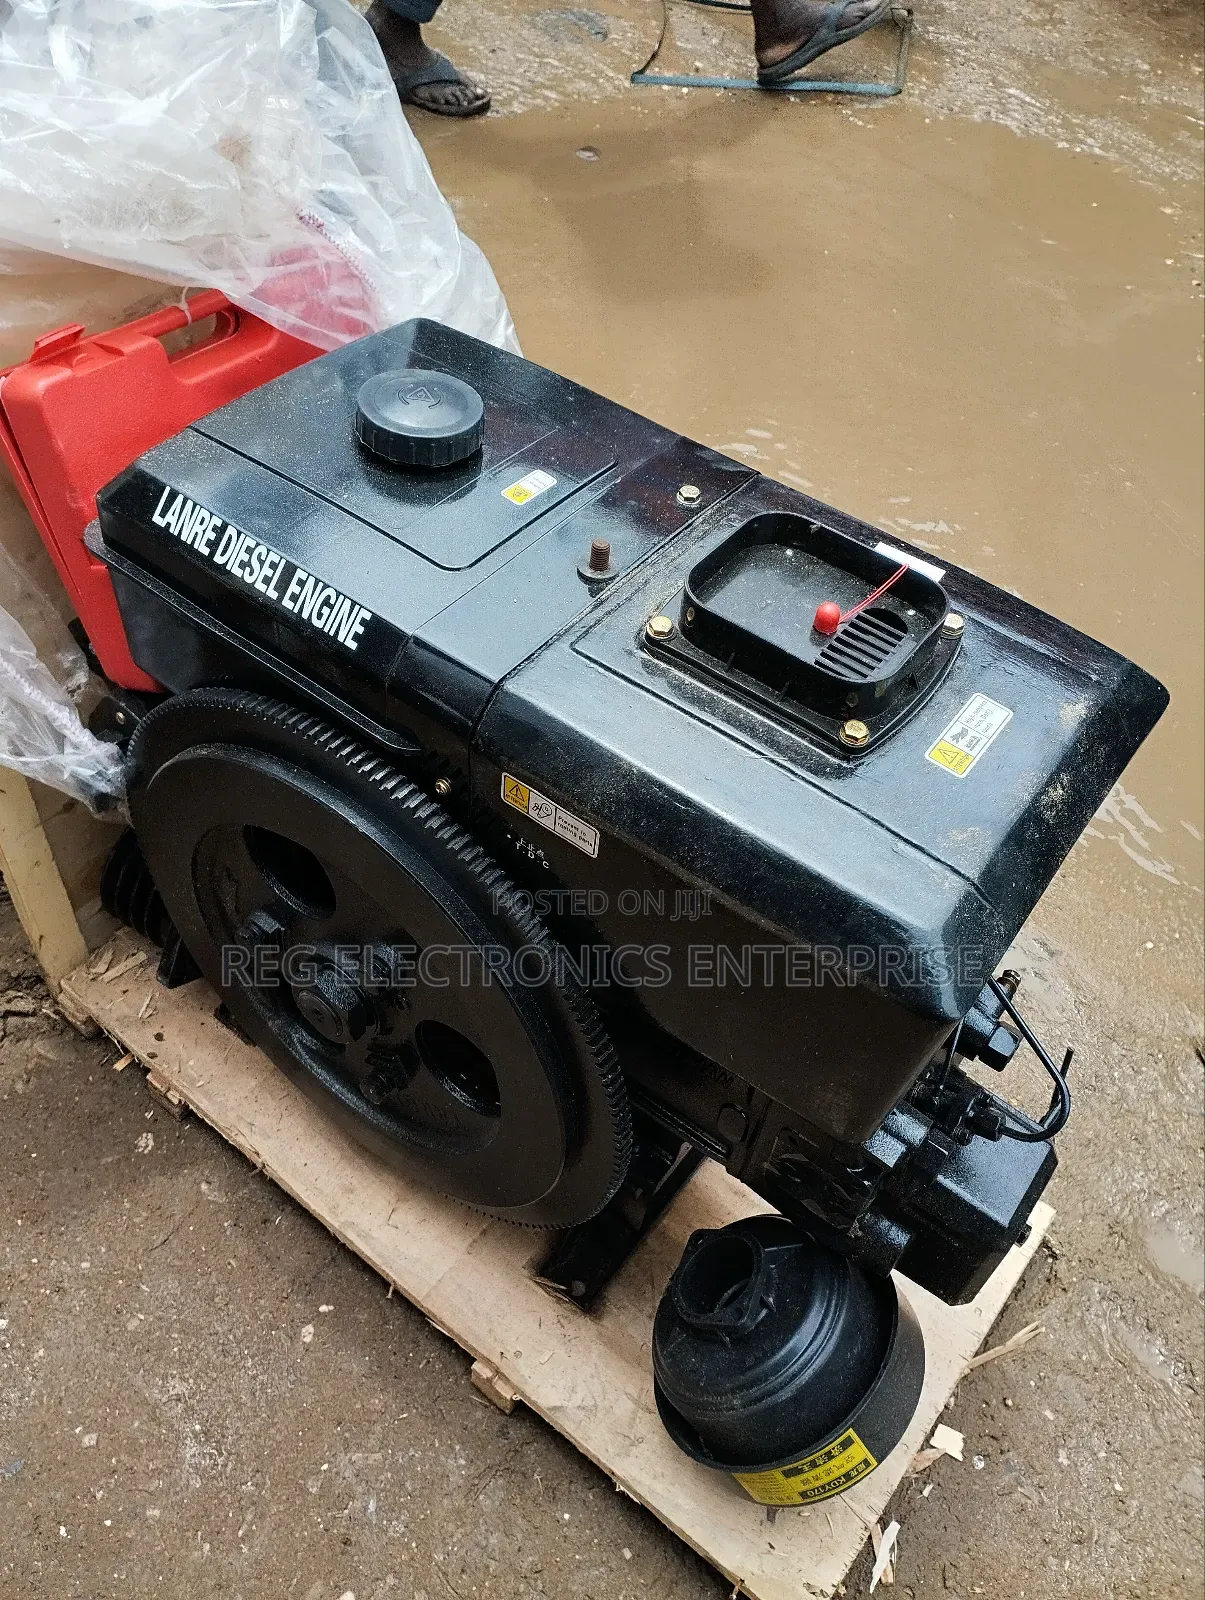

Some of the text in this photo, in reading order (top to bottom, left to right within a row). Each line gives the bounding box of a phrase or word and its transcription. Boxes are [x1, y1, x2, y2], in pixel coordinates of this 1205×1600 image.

[152, 486, 372, 651] LANRE DIESEL ENGINE
[807, 1476, 847, 1497] KDY170
